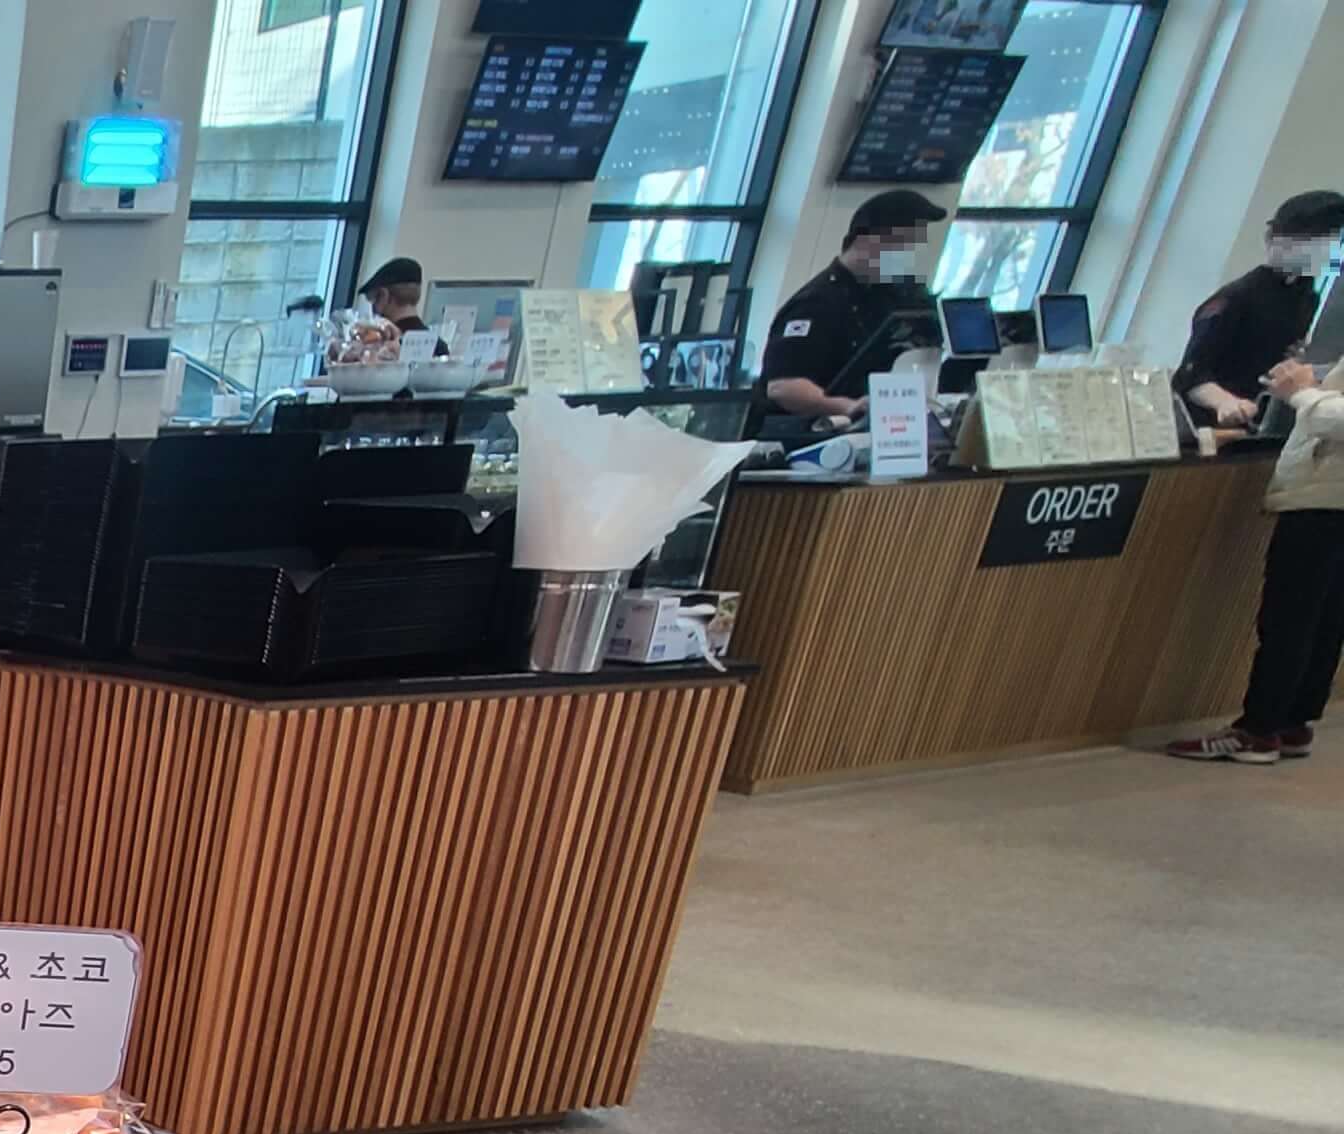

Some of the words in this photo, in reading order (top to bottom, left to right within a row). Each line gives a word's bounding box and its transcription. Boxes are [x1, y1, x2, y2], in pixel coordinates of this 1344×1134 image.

[1026, 483, 1120, 524] ORDER
[1045, 528, 1076, 554] 주문
[30, 951, 111, 984] 초코
